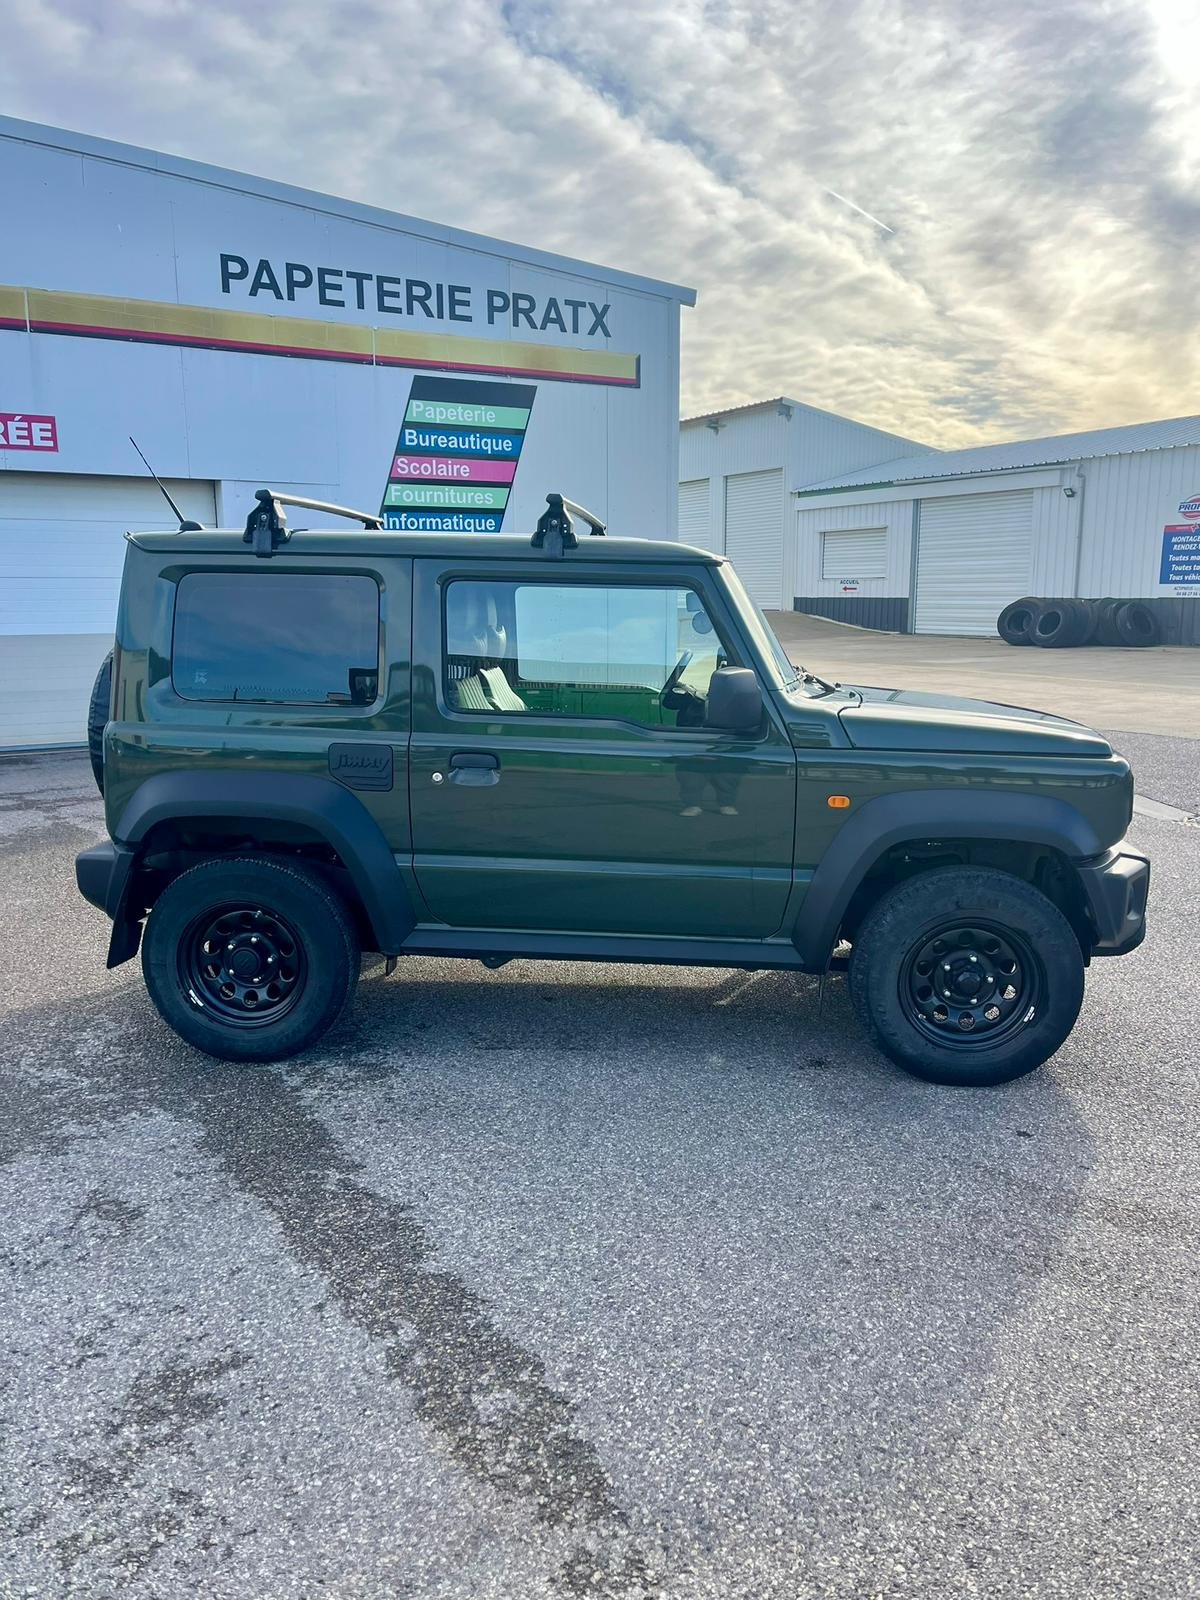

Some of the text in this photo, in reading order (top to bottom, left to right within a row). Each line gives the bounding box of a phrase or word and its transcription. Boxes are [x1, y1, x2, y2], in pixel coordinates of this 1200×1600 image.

[220, 253, 612, 338] PAPETERIE PRATX
[412, 401, 496, 423] Papeterie
[404, 429, 513, 454] Bureautique
[396, 457, 471, 477] Scolaire
[390, 485, 494, 505] Fournitures
[383, 513, 496, 533] Informatique
[1168, 554, 1189, 562] Toutes
